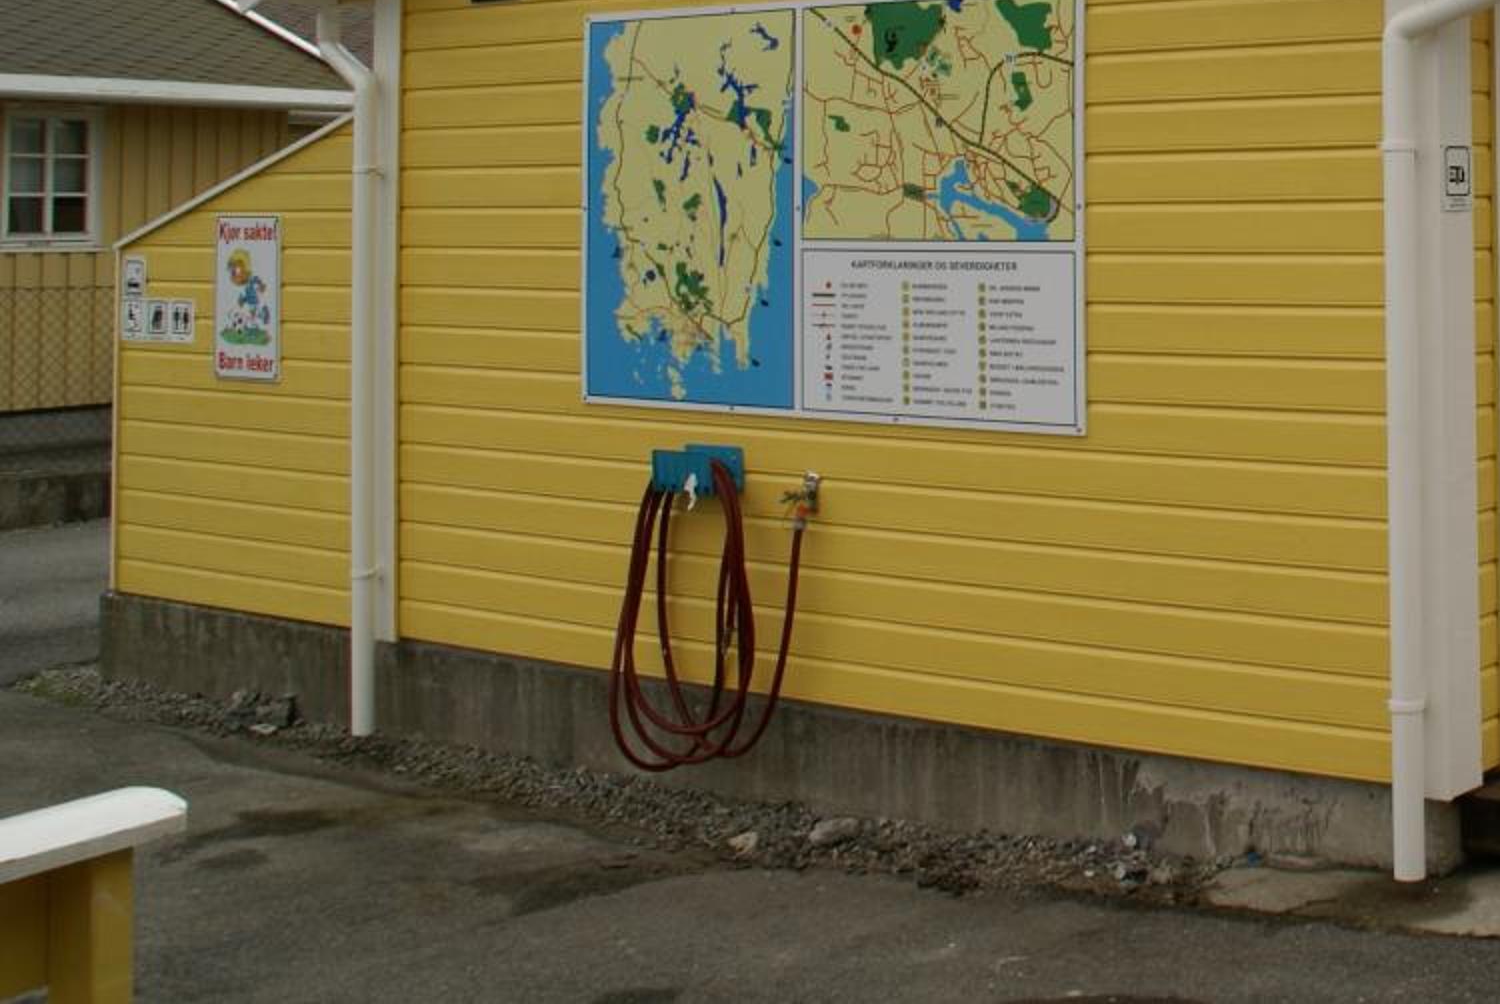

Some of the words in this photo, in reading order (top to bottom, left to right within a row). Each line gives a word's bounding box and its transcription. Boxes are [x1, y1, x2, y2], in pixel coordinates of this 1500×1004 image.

[243, 222, 277, 241] sakte!
[935, 261, 947, 271] OG
[219, 351, 243, 370] Barn
[246, 353, 273, 373] leker
